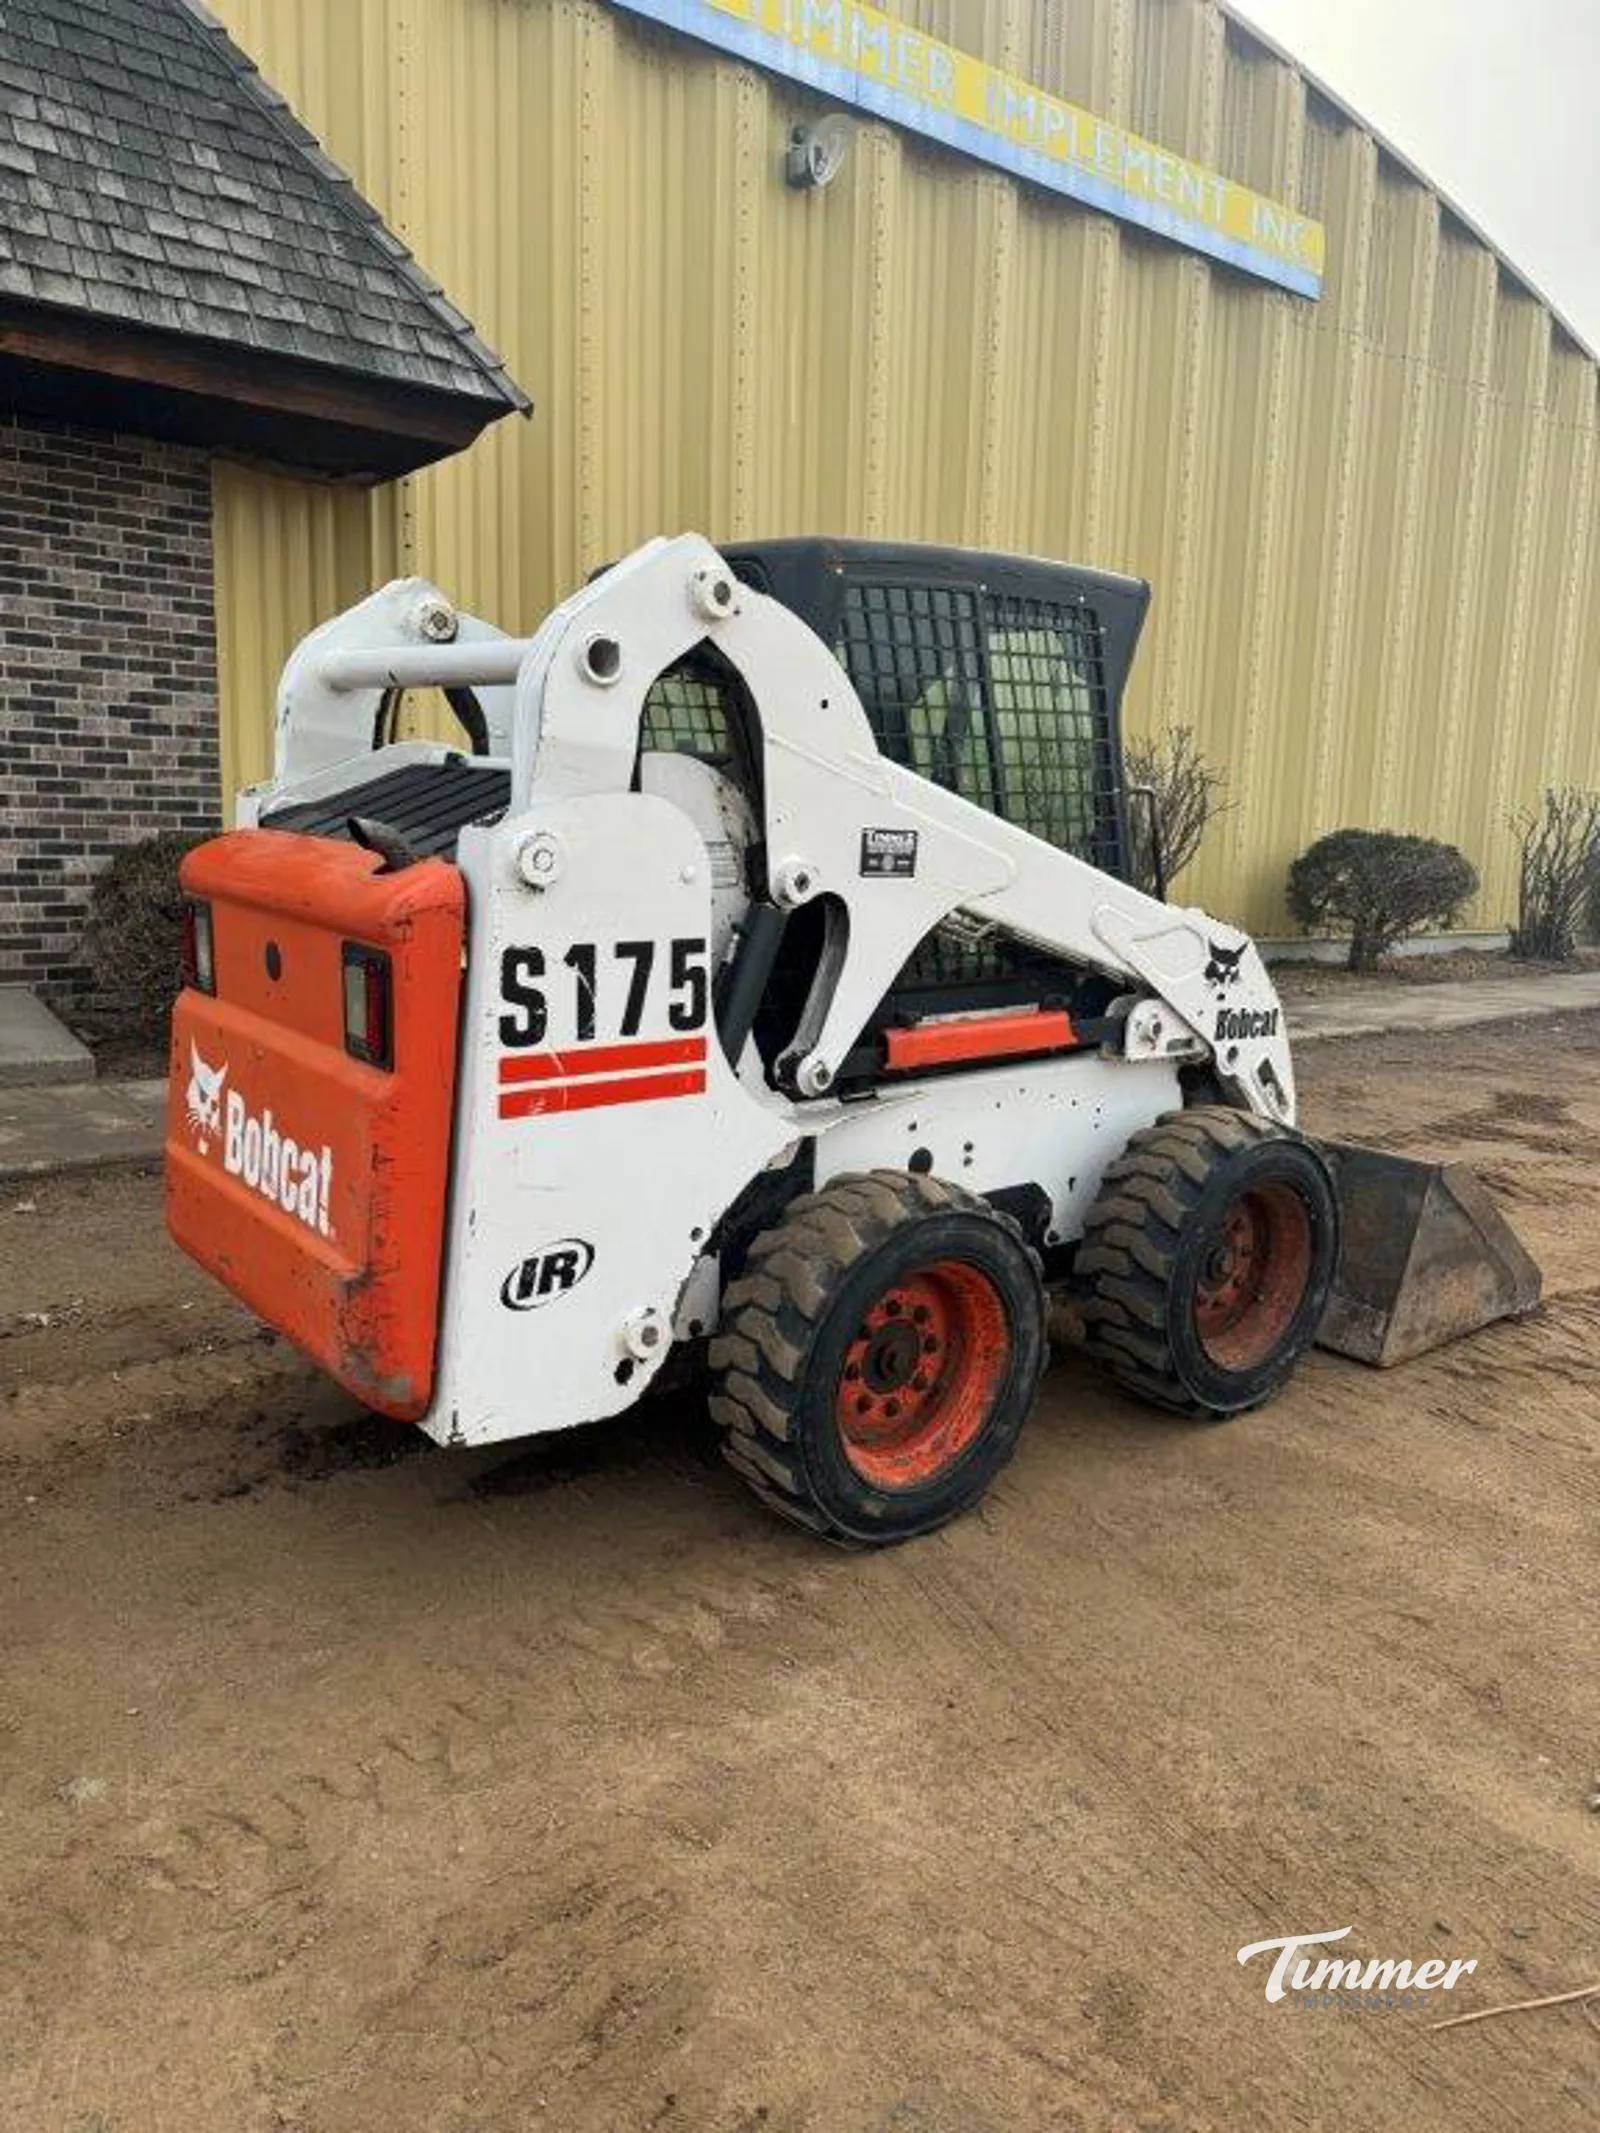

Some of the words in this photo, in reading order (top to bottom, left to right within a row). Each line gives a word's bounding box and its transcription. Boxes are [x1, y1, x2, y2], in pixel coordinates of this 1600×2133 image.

[985, 78, 1230, 223] IMPLEMENT
[498, 938, 707, 1048] S175
[1214, 1008, 1278, 1041] Bobcat
[224, 1087, 336, 1239] Bobcat
[516, 1249, 578, 1300] IR
